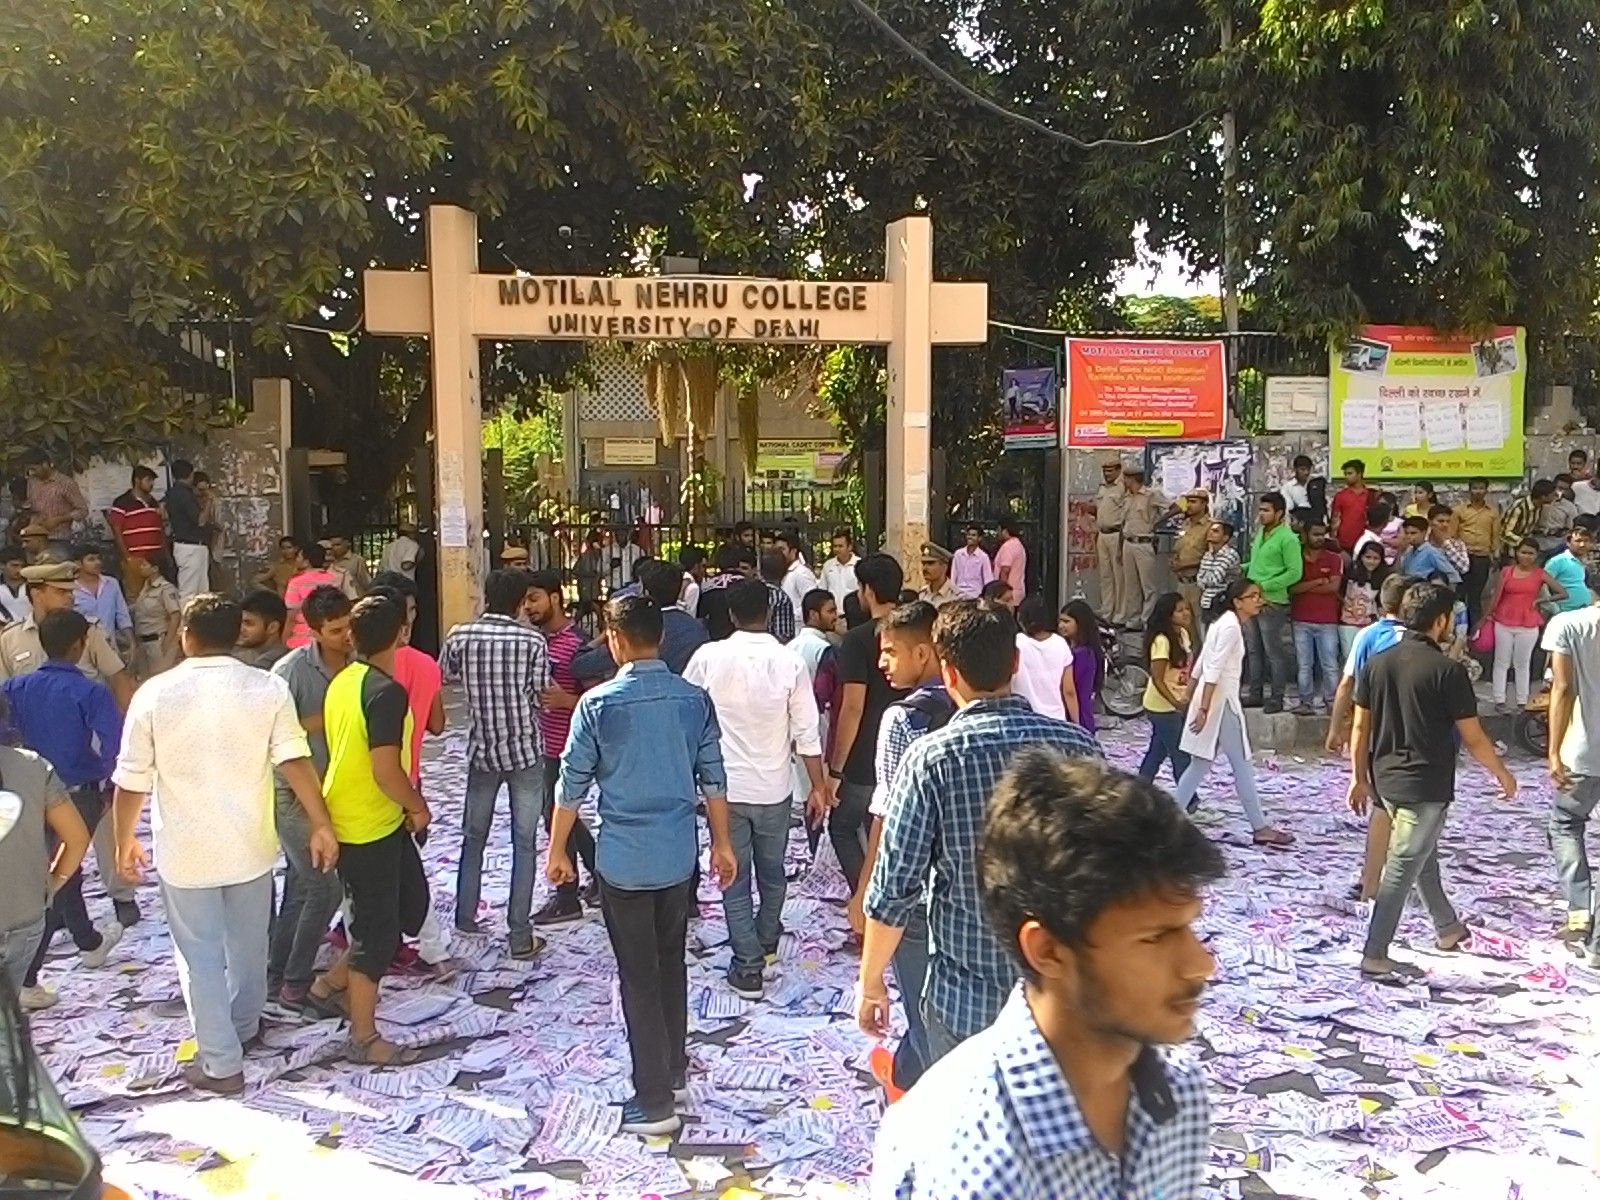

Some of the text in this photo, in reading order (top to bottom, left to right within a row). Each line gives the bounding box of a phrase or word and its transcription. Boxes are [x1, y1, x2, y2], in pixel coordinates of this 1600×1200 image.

[499, 278, 867, 311] MOTILAL NEHRU COLLEGE
[548, 313, 691, 337] UNIVERSITY
[708, 316, 737, 339] OF
[1379, 385, 1405, 398] दिल्ली
[1407, 386, 1420, 398] को
[1473, 386, 1481, 398] में
